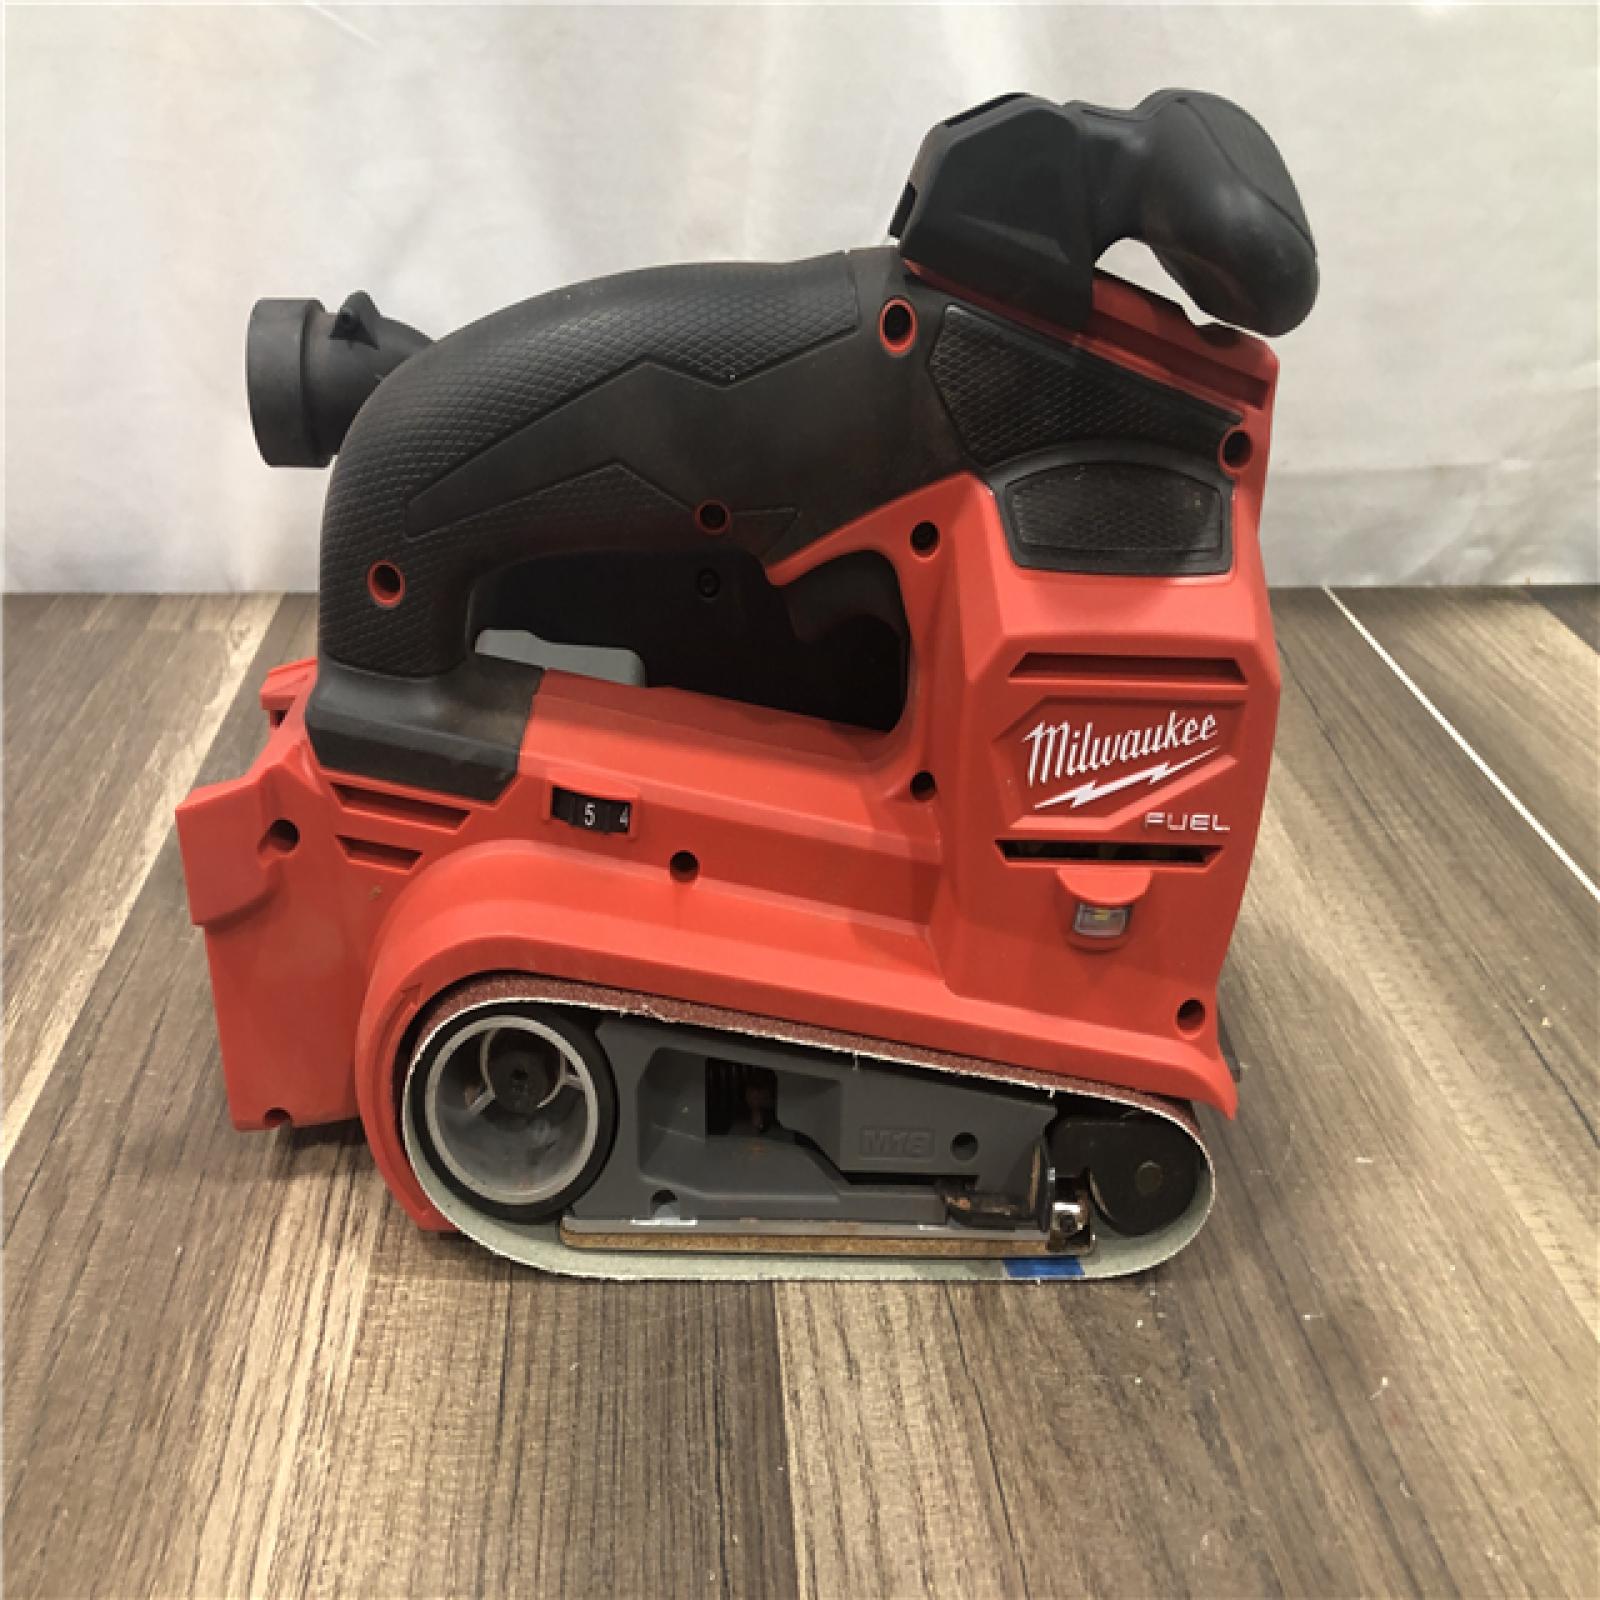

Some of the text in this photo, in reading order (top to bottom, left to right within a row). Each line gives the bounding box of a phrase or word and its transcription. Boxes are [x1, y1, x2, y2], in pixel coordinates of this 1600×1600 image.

[1022, 710, 1218, 788] Milwaukee
[585, 802, 596, 826] 5
[1145, 812, 1231, 831] FUEL
